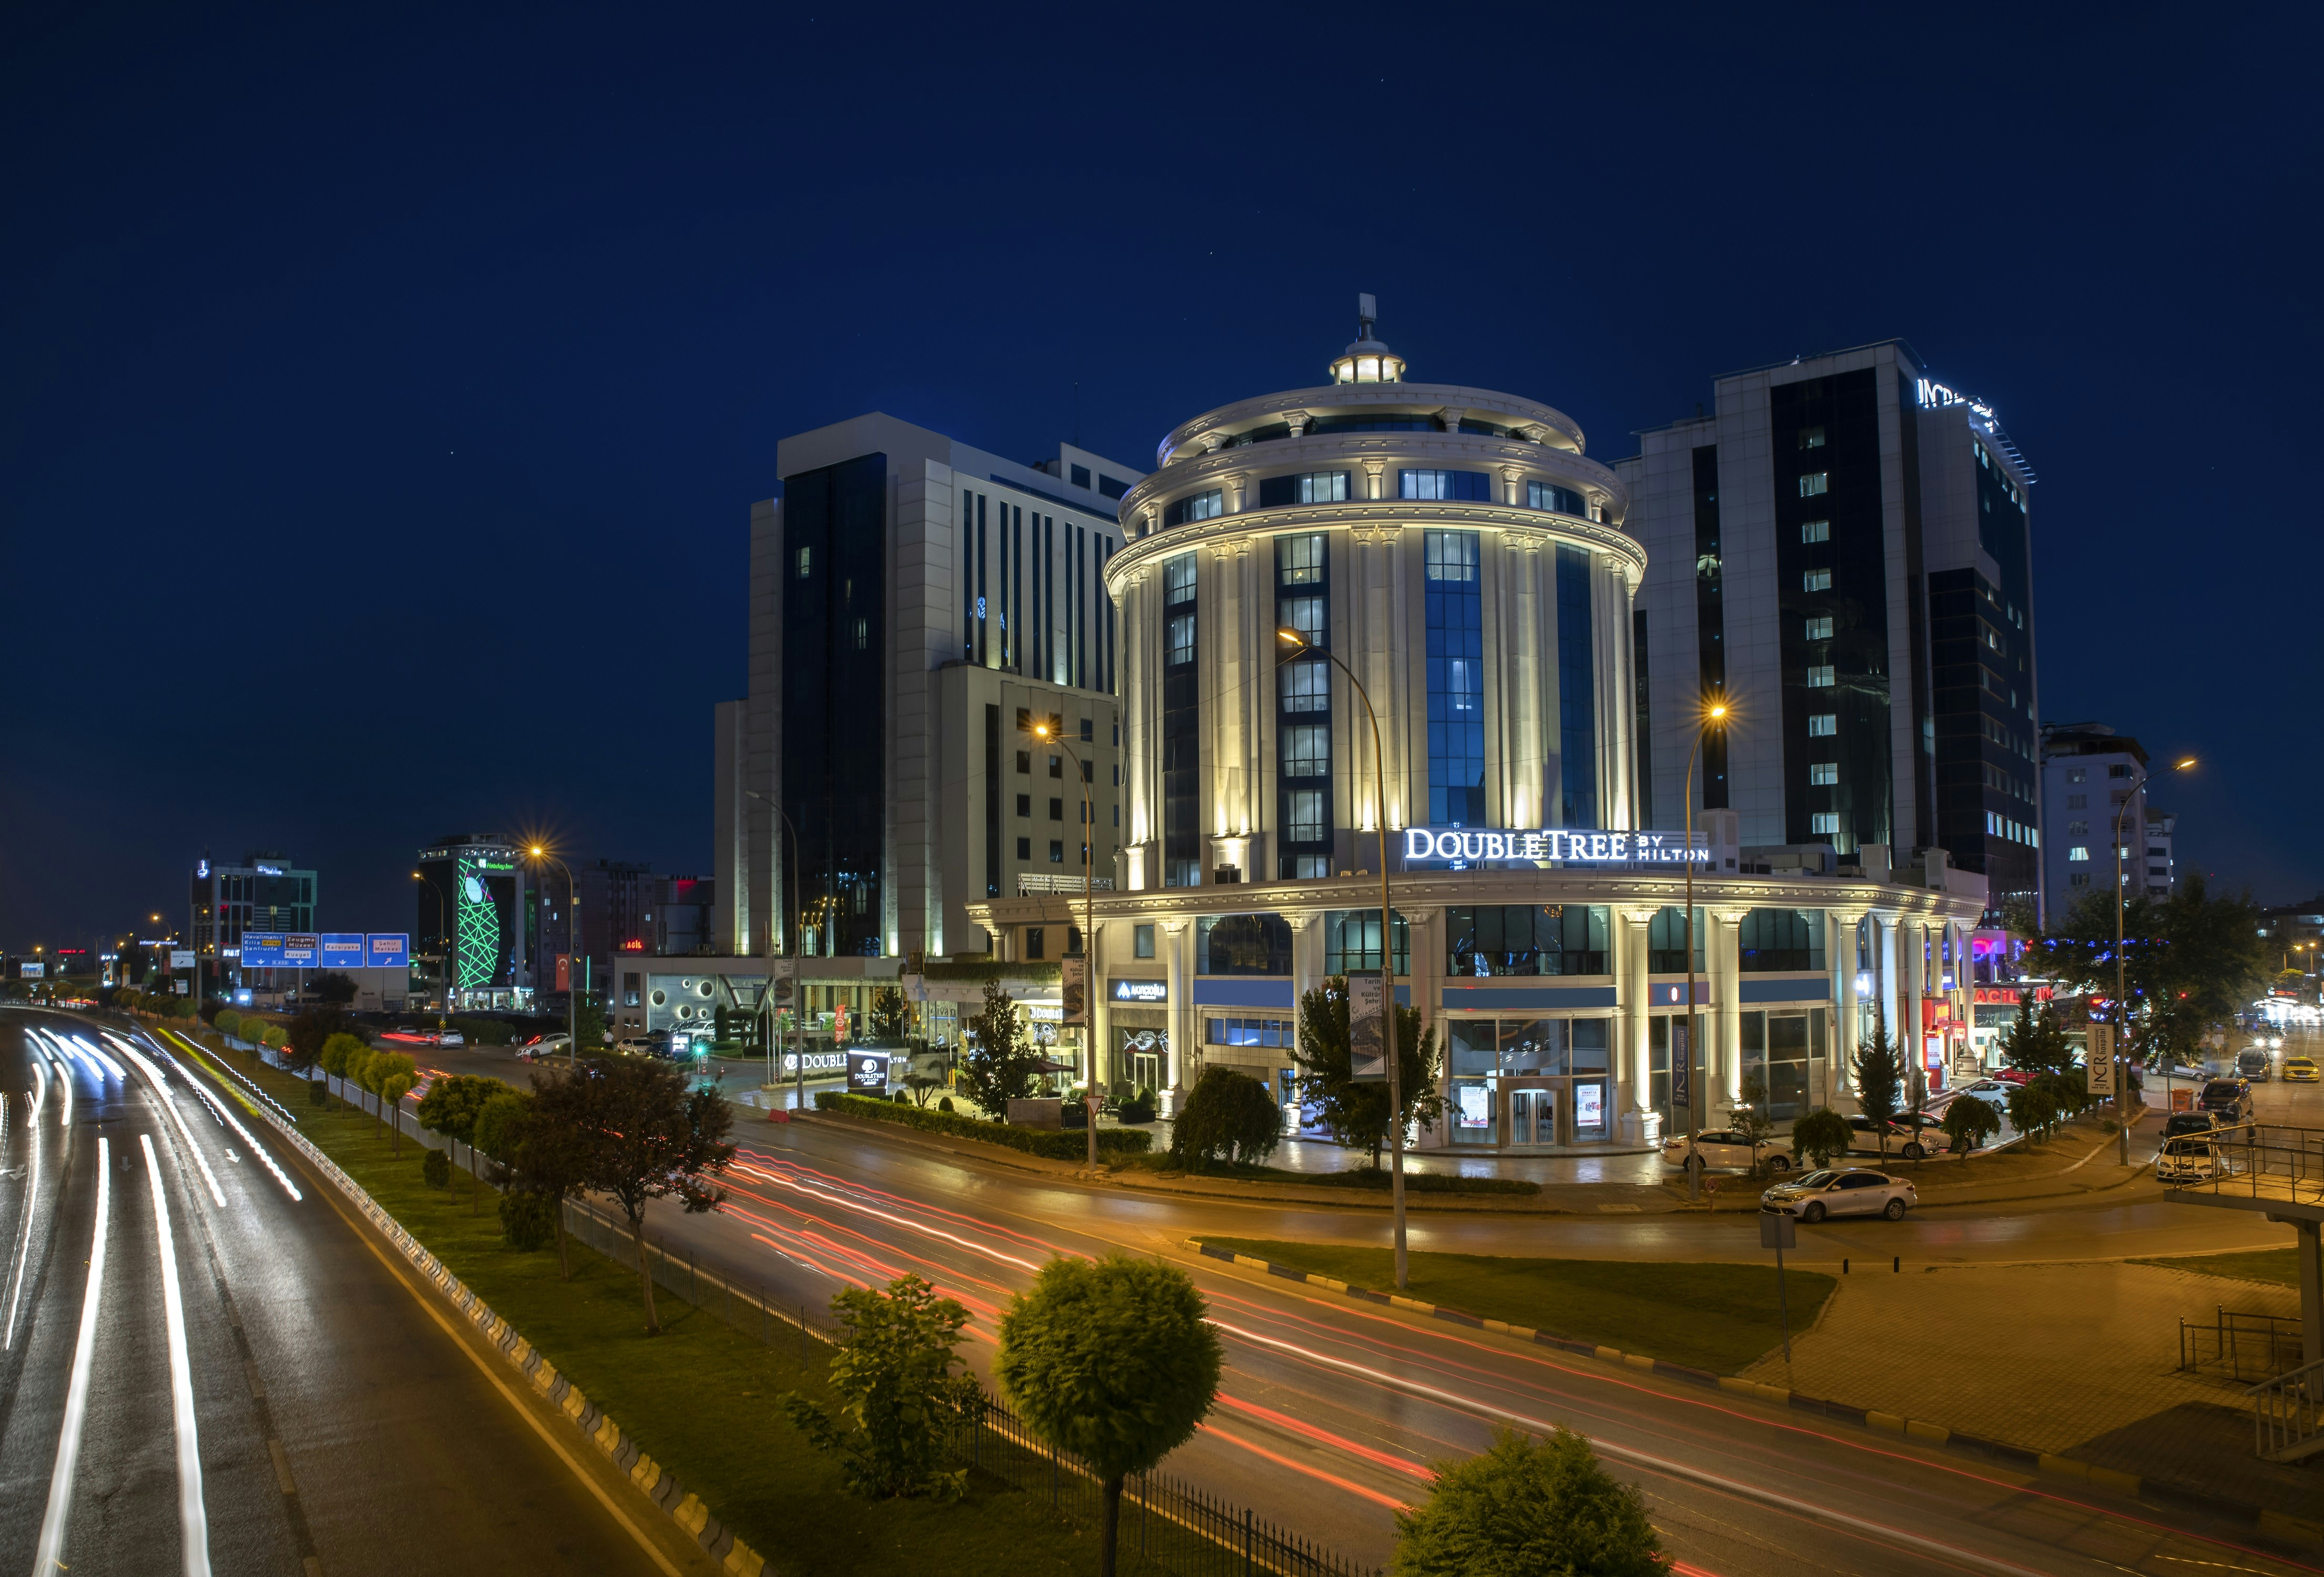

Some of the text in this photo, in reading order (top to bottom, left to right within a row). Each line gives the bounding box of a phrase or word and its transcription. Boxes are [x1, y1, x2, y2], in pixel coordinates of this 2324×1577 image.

[1638, 835, 1663, 847] BY
[1638, 848, 1709, 861] HILTON
[2099, 1029, 2107, 1054] hospital
